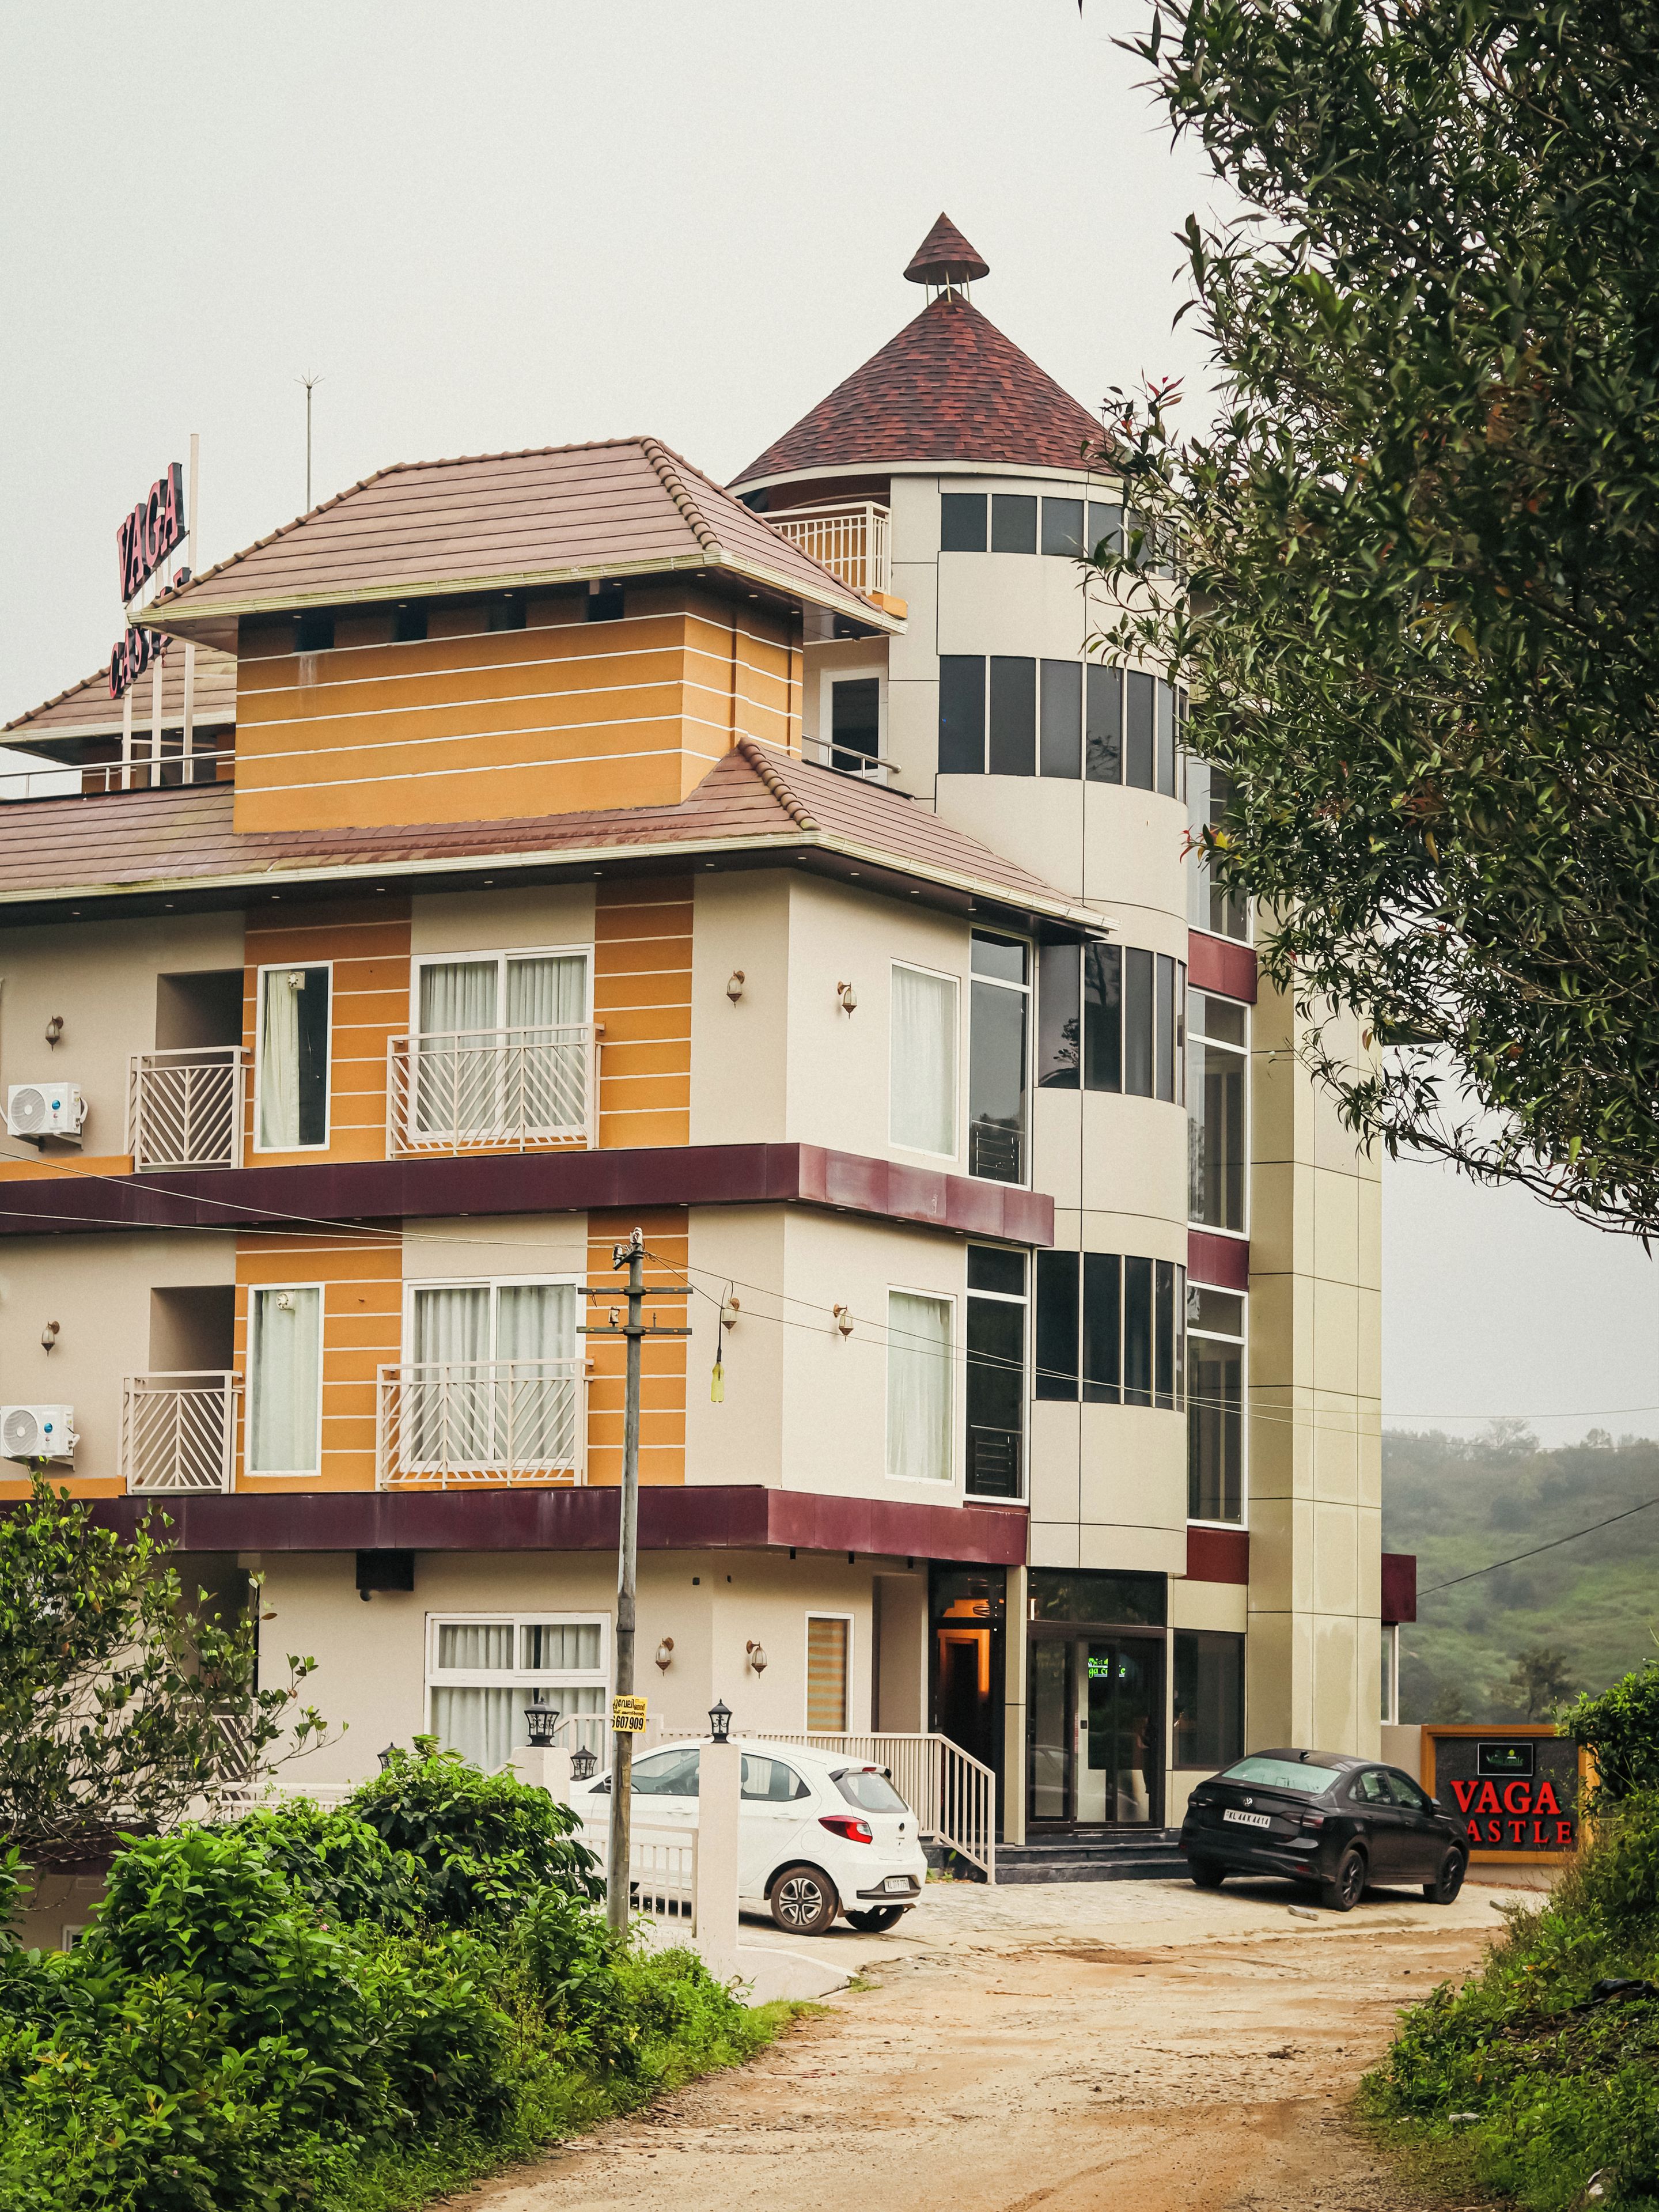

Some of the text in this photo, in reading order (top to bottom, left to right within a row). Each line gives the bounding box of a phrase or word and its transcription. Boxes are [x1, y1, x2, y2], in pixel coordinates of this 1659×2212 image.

[117, 463, 185, 603] VAGA
[1450, 1781, 1560, 1814] VAGA
[1467, 1819, 1572, 1843] ASTLE
